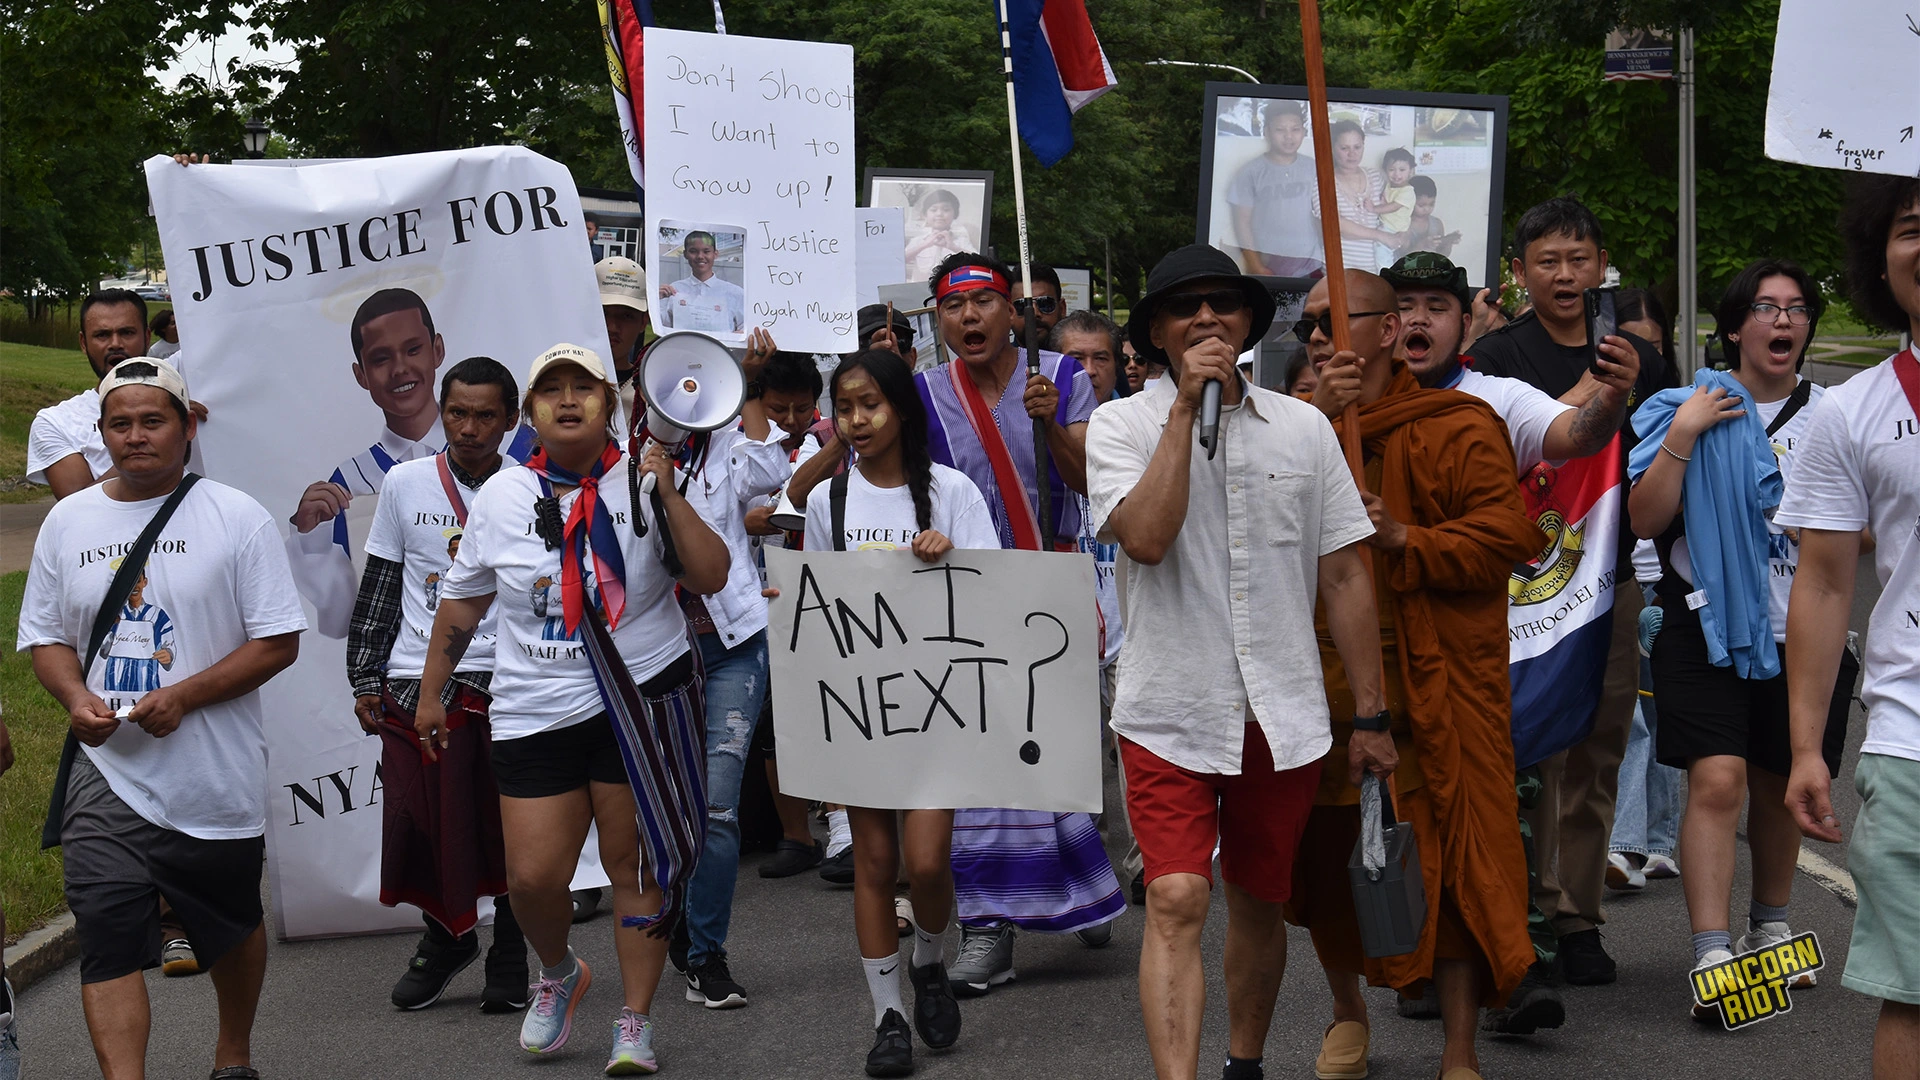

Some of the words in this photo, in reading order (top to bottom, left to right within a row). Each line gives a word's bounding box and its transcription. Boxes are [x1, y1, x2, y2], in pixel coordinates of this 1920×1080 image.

[667, 55, 735, 92] Don't
[668, 104, 689, 135] I
[804, 138, 840, 157] to
[1835, 139, 1885, 160] forever
[672, 164, 751, 196] Grow
[187, 207, 427, 303] JUSTICE
[446, 185, 568, 246] FOR
[758, 220, 840, 255] Justice
[864, 220, 886, 238] For
[753, 301, 799, 327] Nyah
[806, 301, 854, 336] Mway
[544, 349, 570, 361] COWBOY
[572, 349, 585, 357] HAT
[79, 541, 136, 568] JUSTIC
[789, 563, 908, 659] AM
[912, 562, 985, 648] I
[283, 759, 384, 827] NYA
